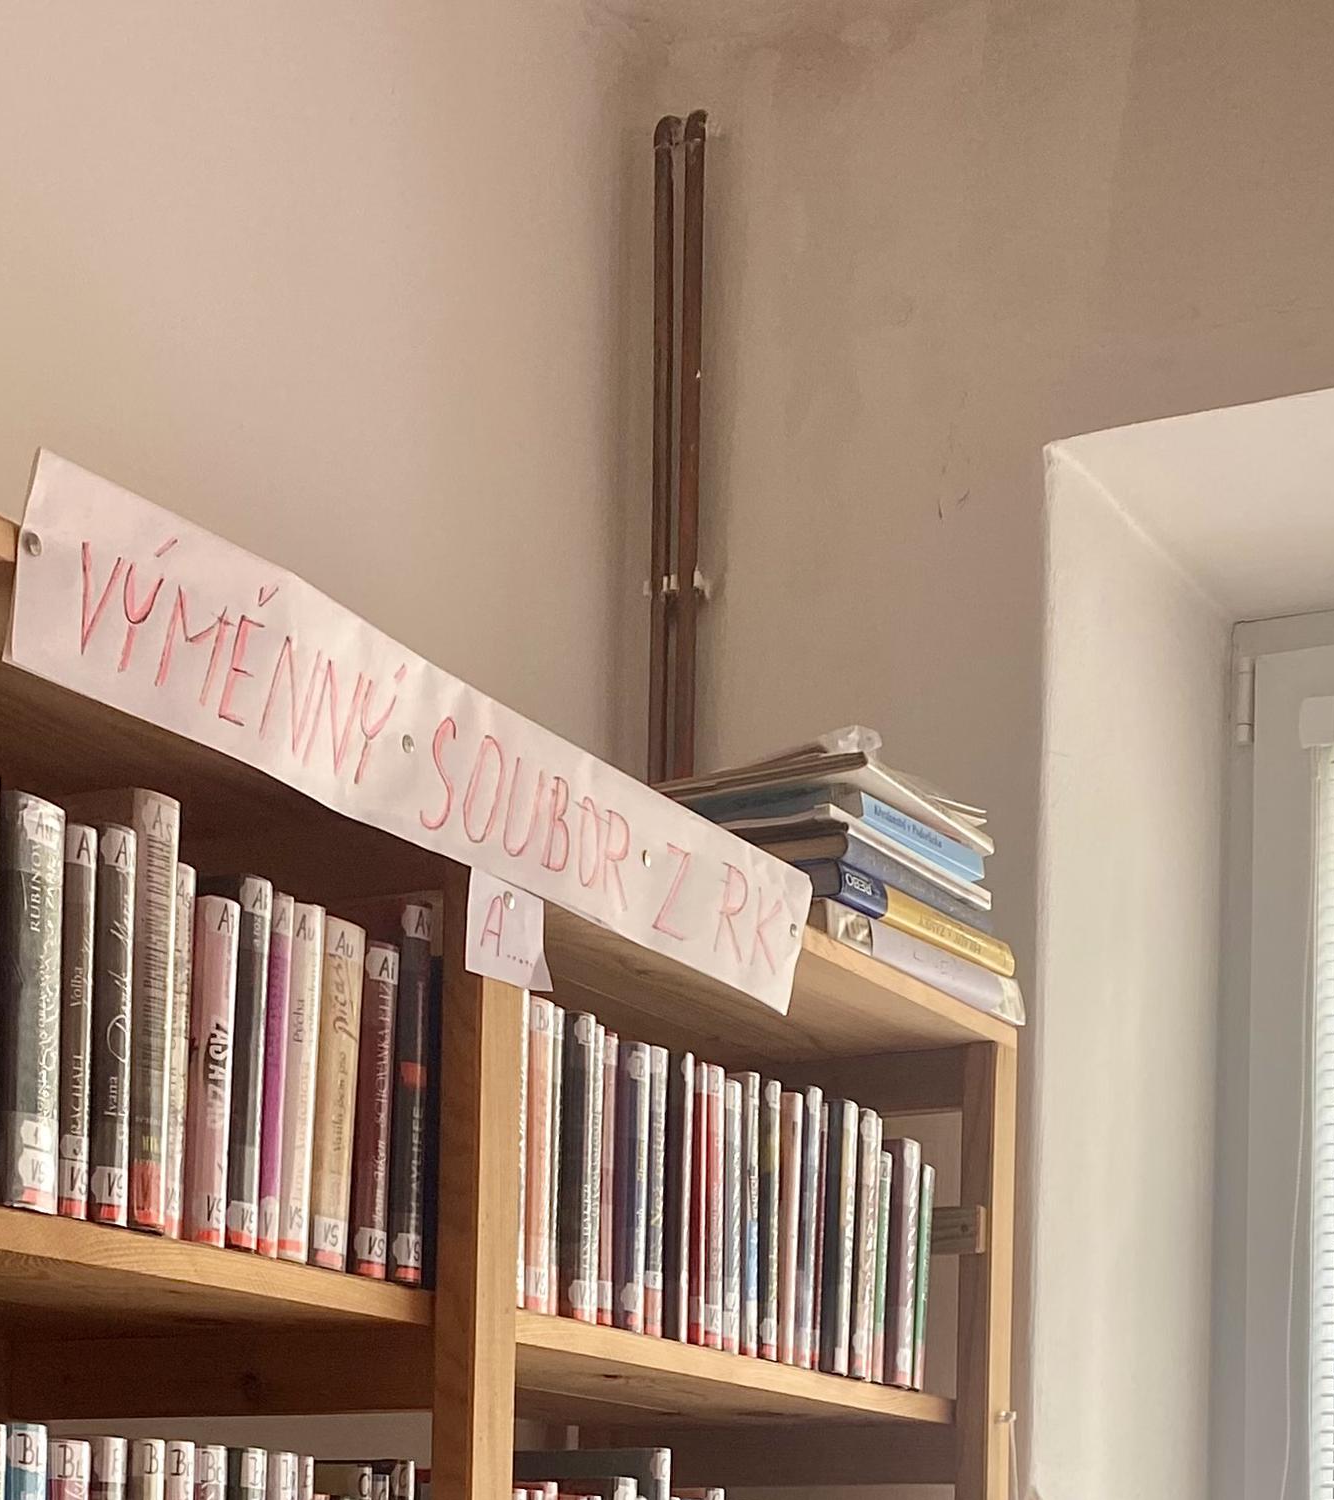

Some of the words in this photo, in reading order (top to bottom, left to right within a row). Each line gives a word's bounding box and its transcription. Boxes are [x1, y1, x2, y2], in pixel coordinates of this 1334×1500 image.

[79, 535, 407, 785] VÝMĚNNÝ
[417, 715, 632, 912] SOUBOR
[651, 842, 691, 941] Z
[713, 862, 783, 975] RK
[104, 1075, 119, 1118] Ivana
